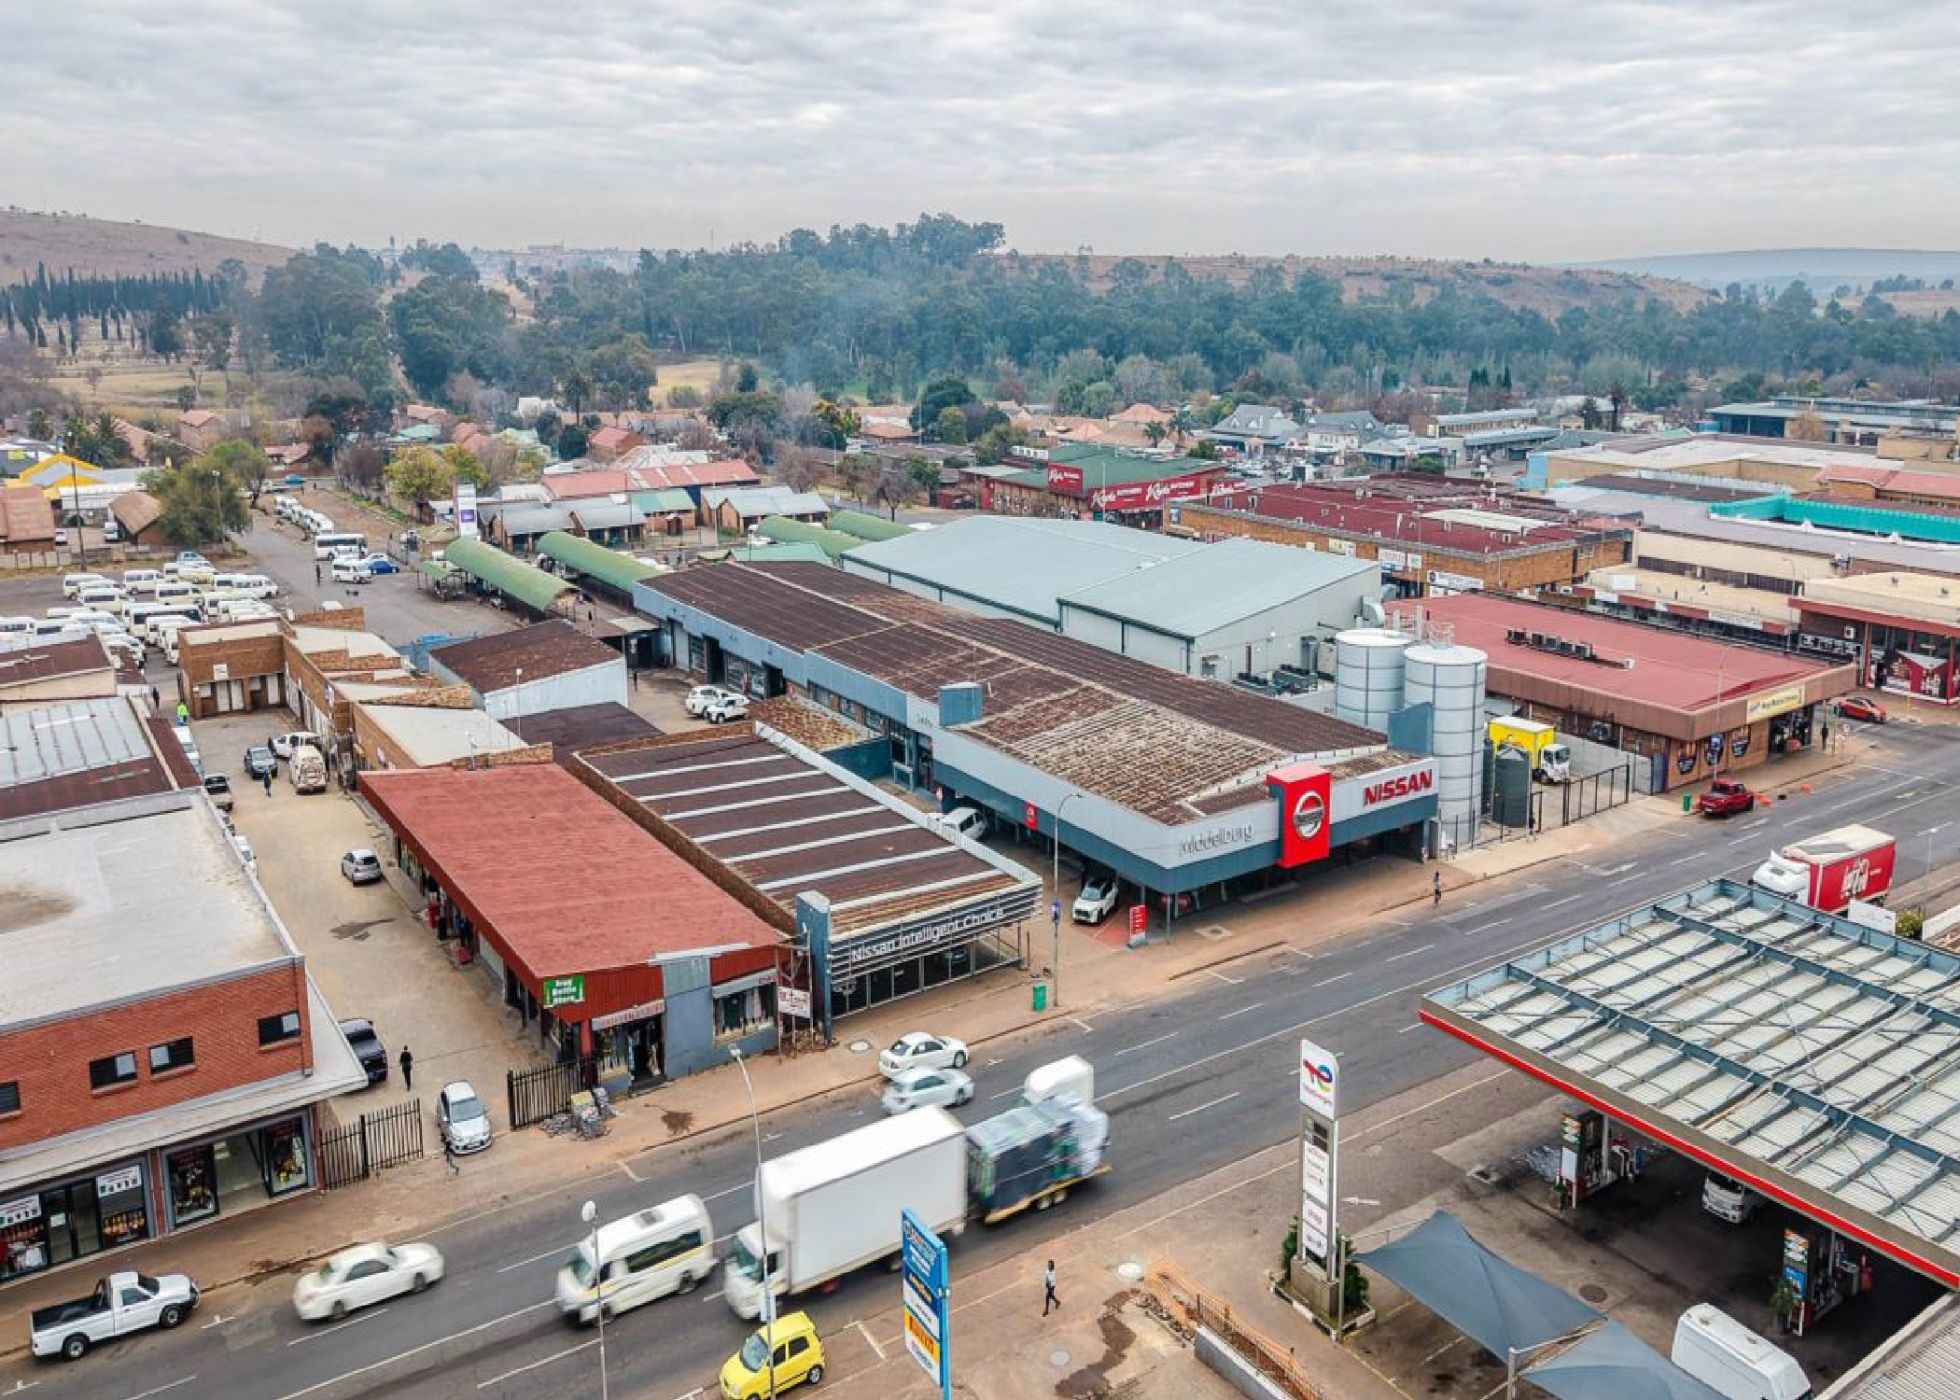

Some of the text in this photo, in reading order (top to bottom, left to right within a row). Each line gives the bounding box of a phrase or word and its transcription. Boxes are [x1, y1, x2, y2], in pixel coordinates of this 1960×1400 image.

[1363, 770, 1433, 805] NISSAN
[852, 908, 1004, 962] Nissan Intelligent Choice
